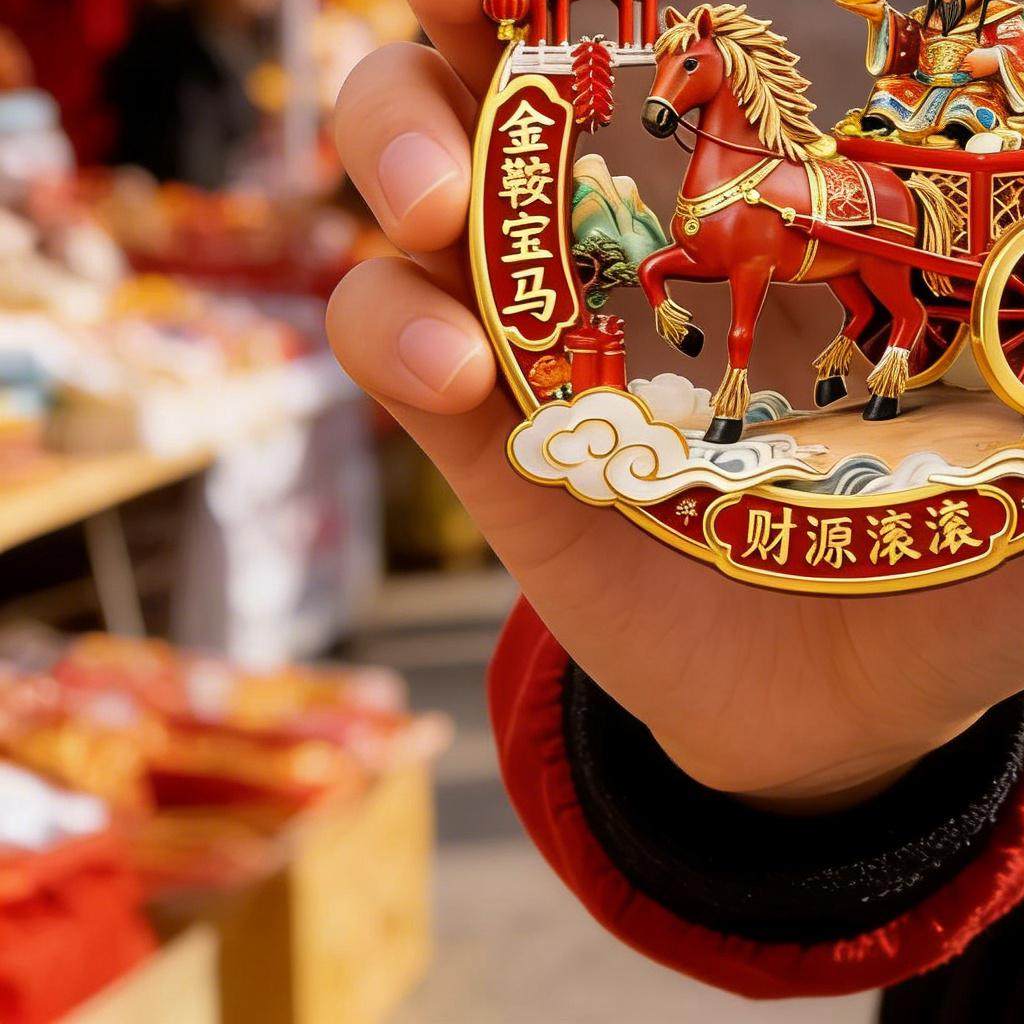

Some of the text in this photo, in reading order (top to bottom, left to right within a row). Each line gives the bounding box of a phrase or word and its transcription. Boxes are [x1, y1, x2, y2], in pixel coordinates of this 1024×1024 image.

[498, 99, 557, 323] 金鞍宝马
[740, 498, 984, 569] 财源滚滚
